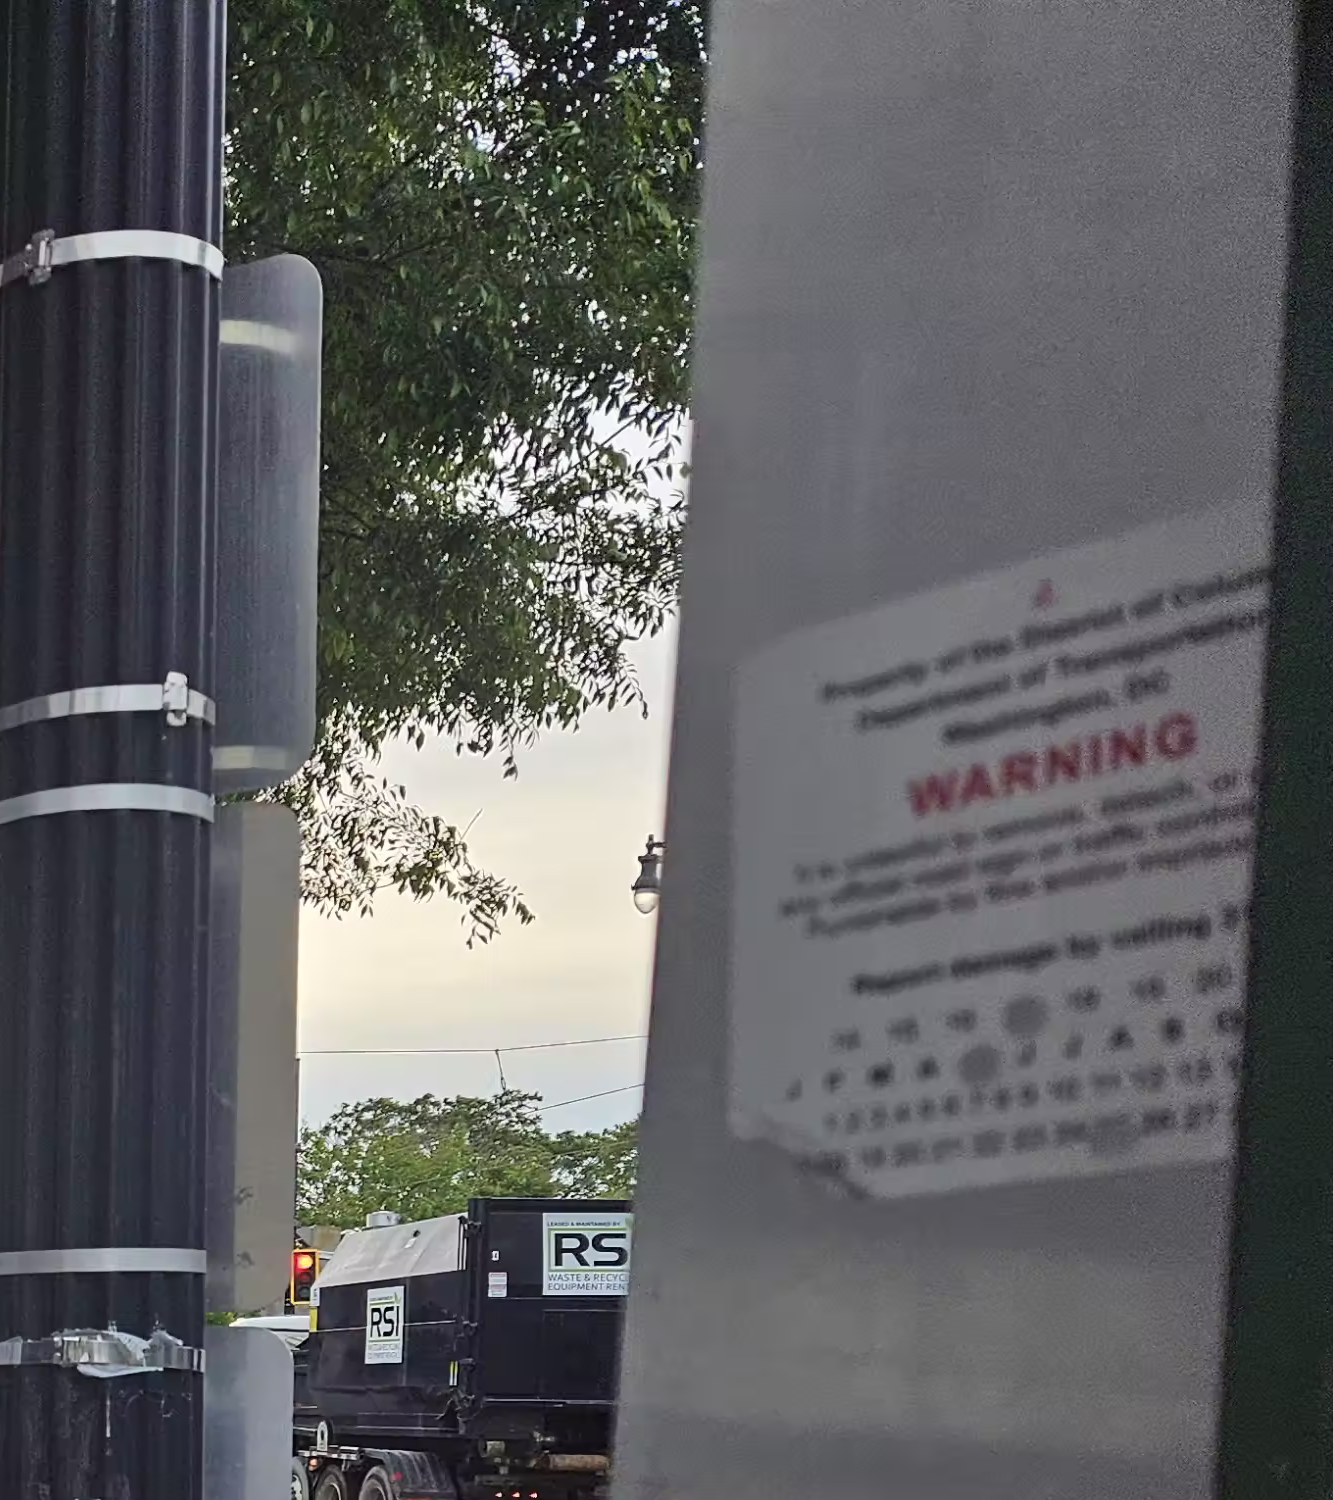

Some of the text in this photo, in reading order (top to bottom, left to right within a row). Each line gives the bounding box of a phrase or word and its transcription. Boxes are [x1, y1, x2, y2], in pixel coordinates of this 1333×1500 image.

[907, 711, 1199, 818] WARNING
[554, 1233, 628, 1267] RS
[548, 1273, 581, 1281] WASTE
[584, 1273, 591, 1281] &
[548, 1283, 603, 1291] EQUIPMENT
[370, 1306, 400, 1337] RSI
